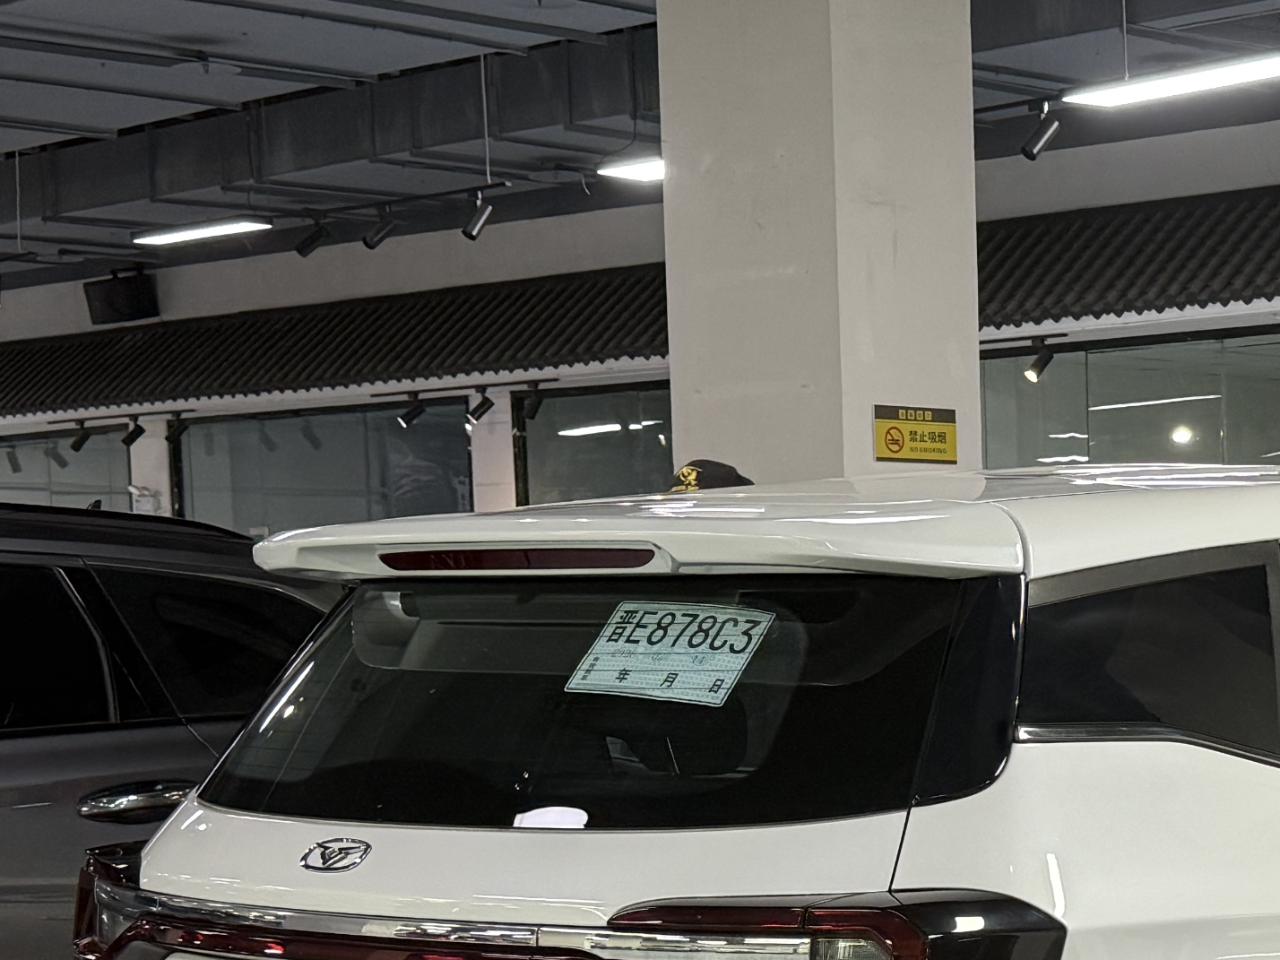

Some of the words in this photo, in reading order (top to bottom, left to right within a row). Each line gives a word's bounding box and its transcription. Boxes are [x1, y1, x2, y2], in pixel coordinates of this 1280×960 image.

[908, 430, 947, 444] 禁止吸烟
[606, 609, 763, 654] 晋E878C3
[615, 667, 633, 683] 年
[659, 672, 679, 688] 月
[708, 678, 725, 694] 日
